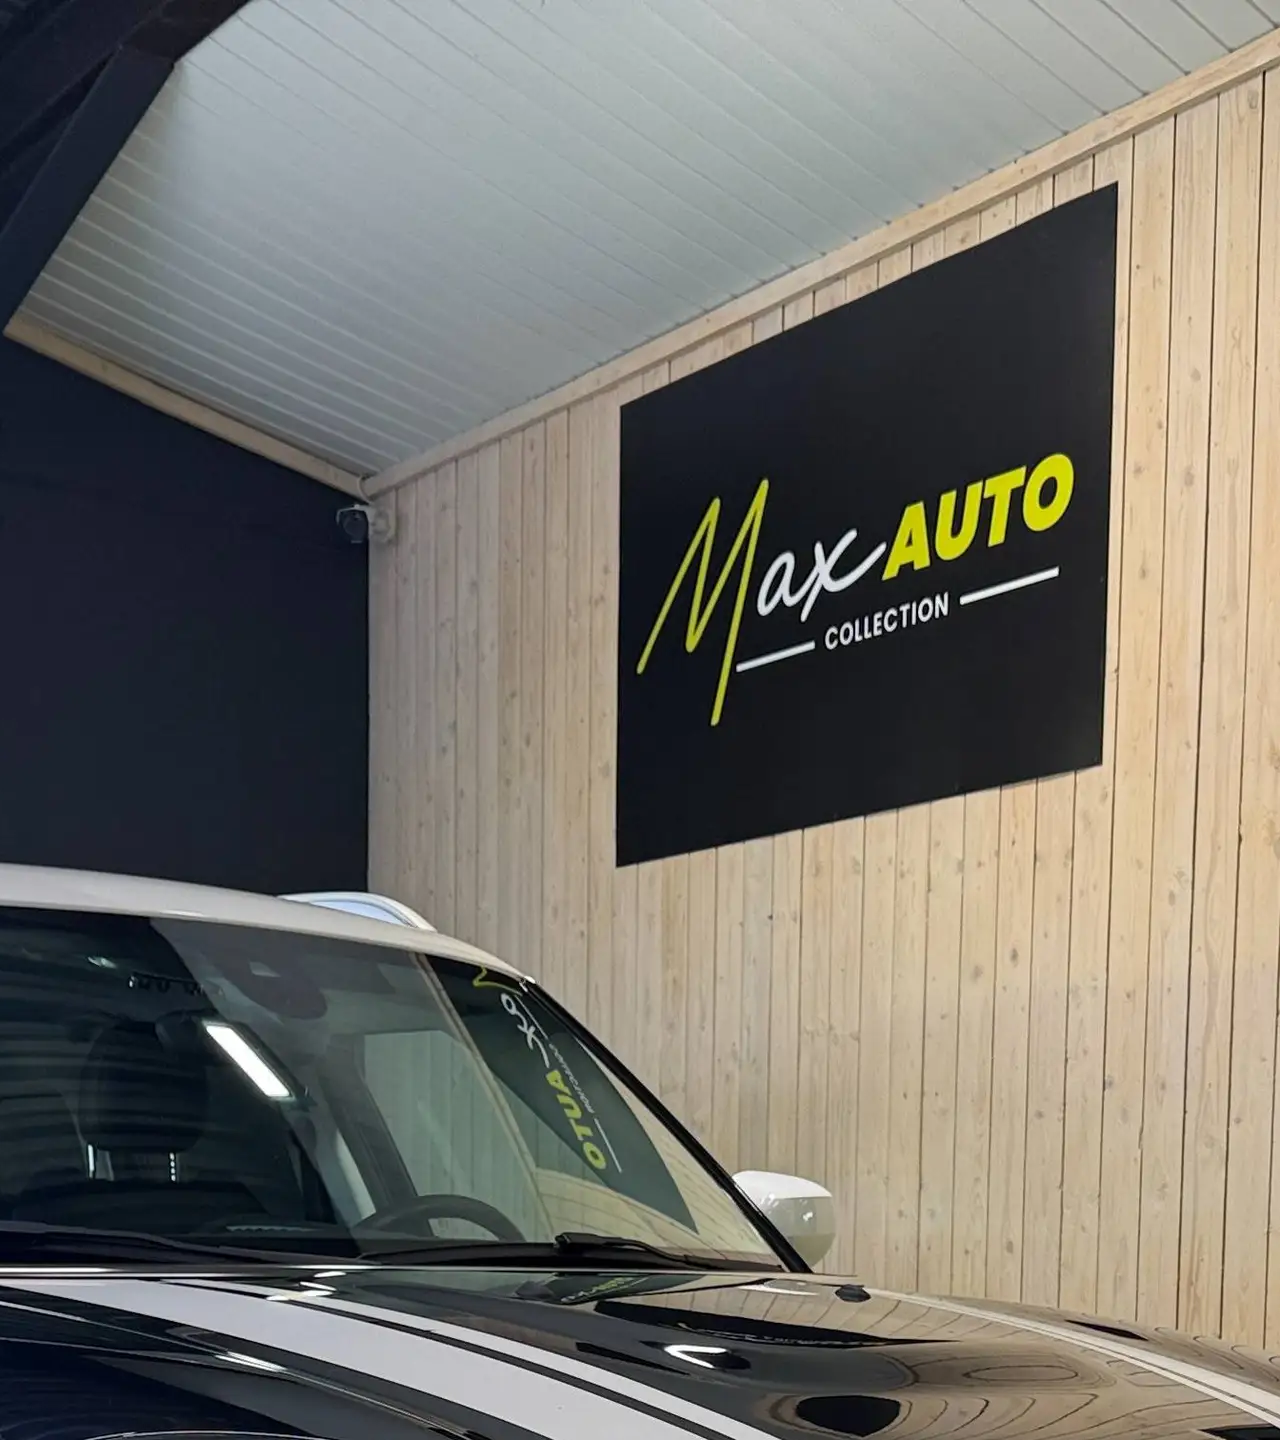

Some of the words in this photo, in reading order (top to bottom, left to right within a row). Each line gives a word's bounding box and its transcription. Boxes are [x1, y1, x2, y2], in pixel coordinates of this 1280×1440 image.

[636, 478, 887, 726] Max
[882, 453, 1074, 580] AUTO
[824, 592, 950, 650] COLLECTION
